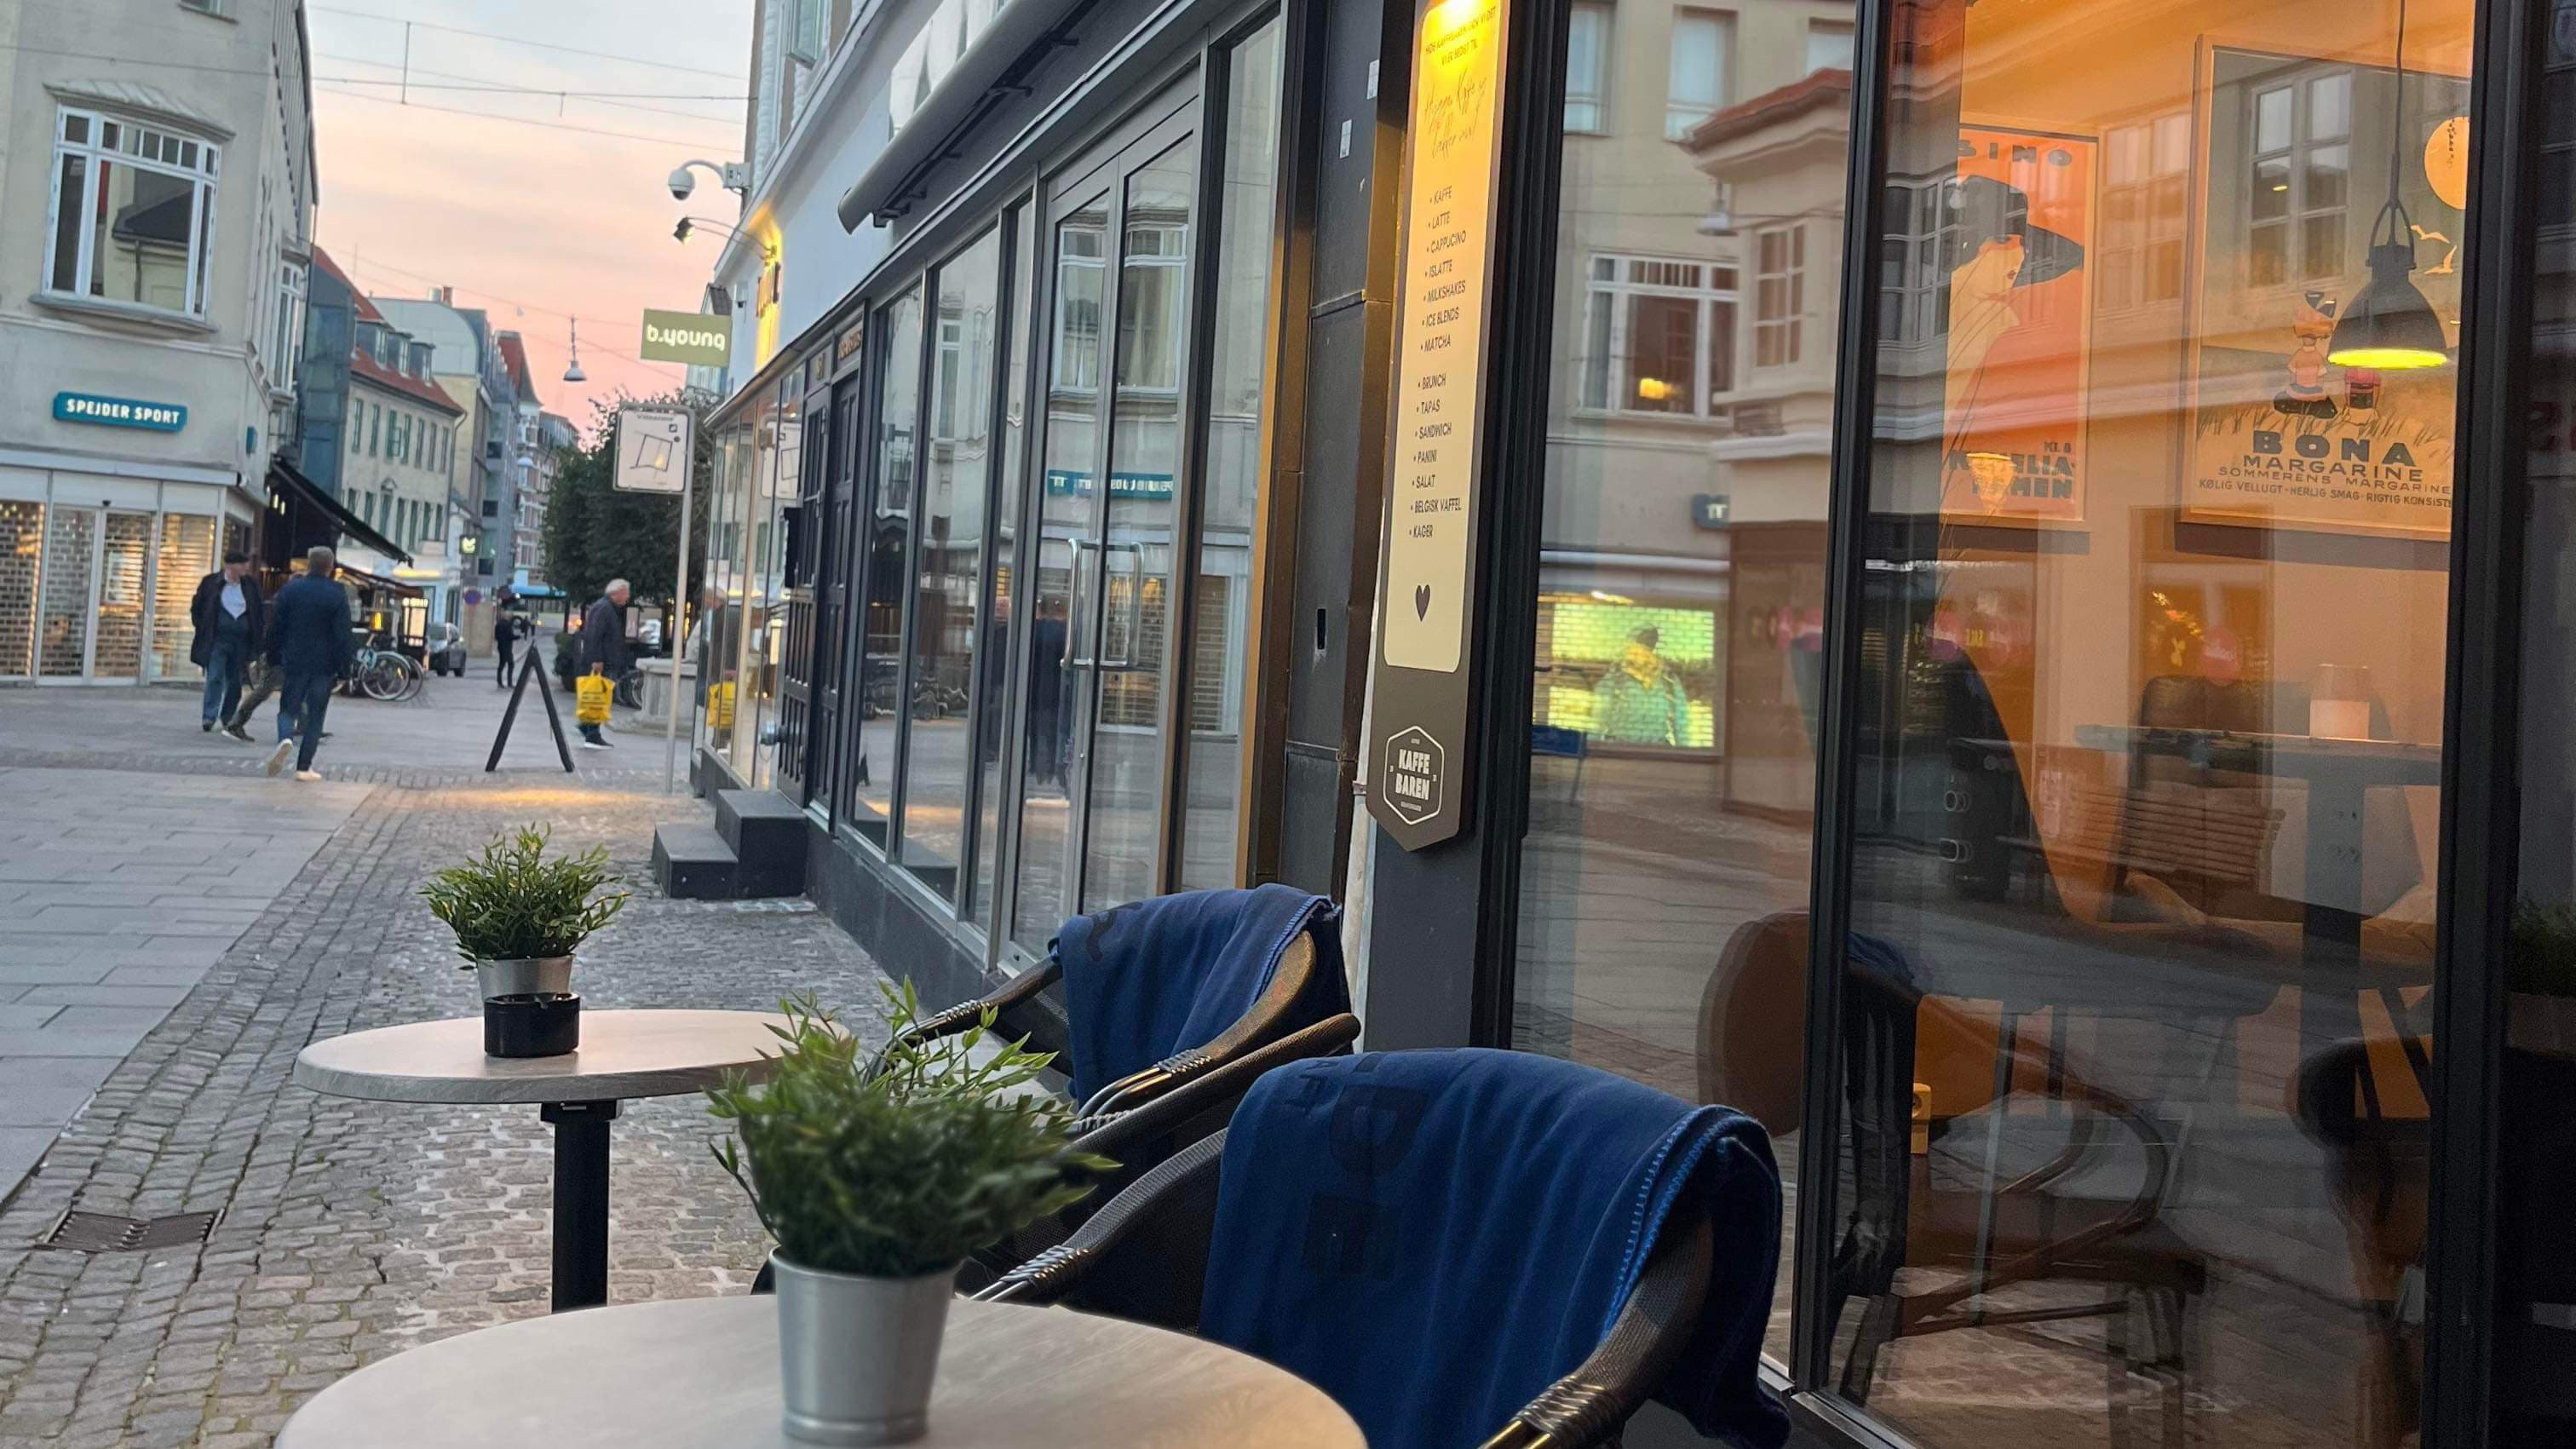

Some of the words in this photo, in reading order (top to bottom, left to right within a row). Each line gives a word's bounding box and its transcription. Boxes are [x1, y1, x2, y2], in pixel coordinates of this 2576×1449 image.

[1434, 186, 1452, 204] KAFFE
[1432, 211, 1450, 229] LATTE
[1429, 259, 1452, 279] ISLATTE
[1428, 280, 1465, 302] MILKSHAKES
[1426, 313, 1436, 327] ICE
[1437, 307, 1459, 325] BLENDS
[647, 324, 726, 351] b.young
[1424, 334, 1451, 352] MATCHA
[1423, 373, 1446, 389] BRUNCH
[66, 398, 130, 419] SPEJDER
[134, 406, 180, 424] SPORT
[1421, 399, 1440, 415] TAPAS
[1419, 423, 1452, 439] SANDWICH
[1417, 450, 1437, 463] PANINI
[2253, 430, 2417, 467] BONA
[2244, 455, 2423, 482] MARGARINE
[1417, 474, 1435, 488] SALAT
[2199, 478, 2233, 491] KØLIG
[2218, 467, 2332, 485] SOMMERENS
[2346, 477, 2451, 494] MARGARINE
[1415, 499, 1438, 513] BELGISK
[1440, 497, 1461, 511] VAFFEL
[1413, 525, 1433, 538] KAGER
[1399, 749, 1431, 774] KAFFE
[1395, 773, 1430, 800] BAREN
